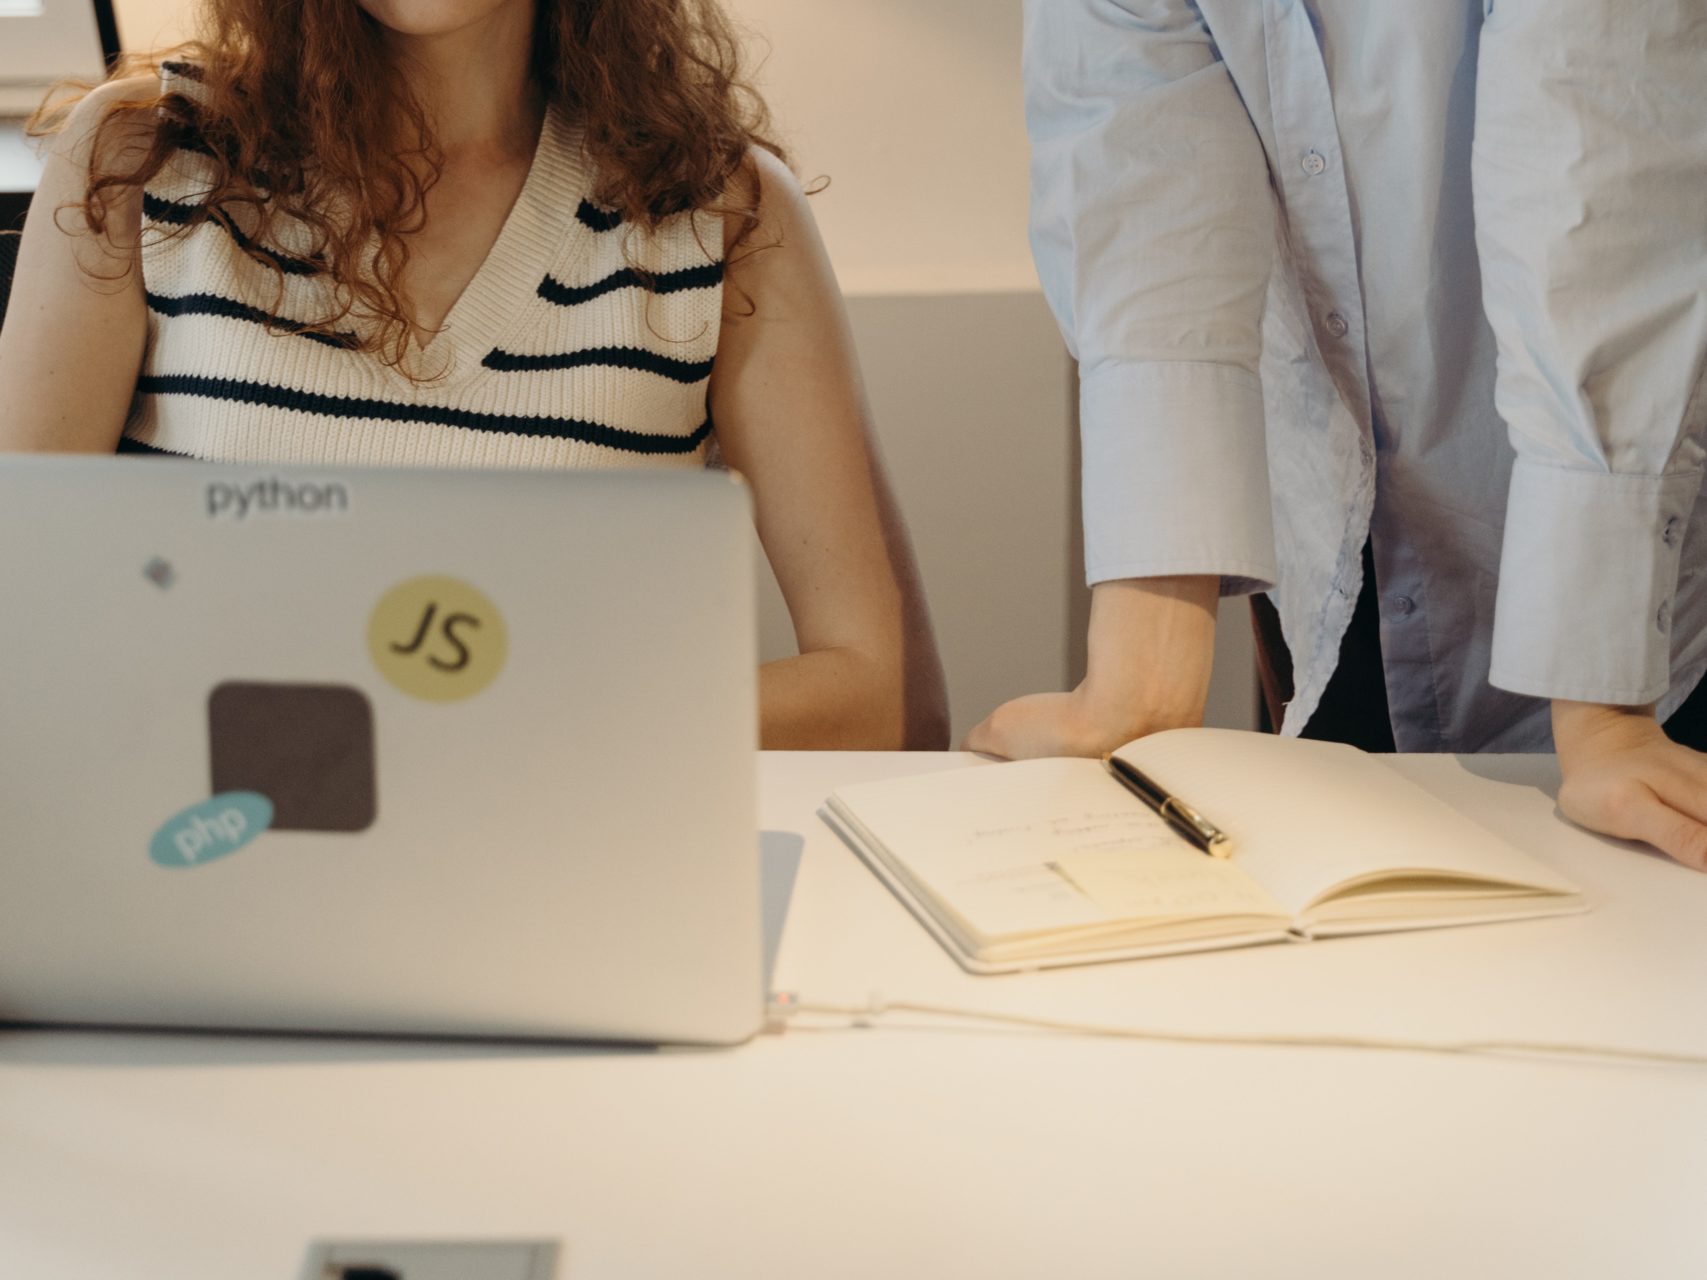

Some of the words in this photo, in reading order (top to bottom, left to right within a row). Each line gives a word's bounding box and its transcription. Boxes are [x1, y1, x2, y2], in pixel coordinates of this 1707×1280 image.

[206, 475, 349, 519] python
[389, 601, 483, 673] JS
[175, 808, 248, 861] php
